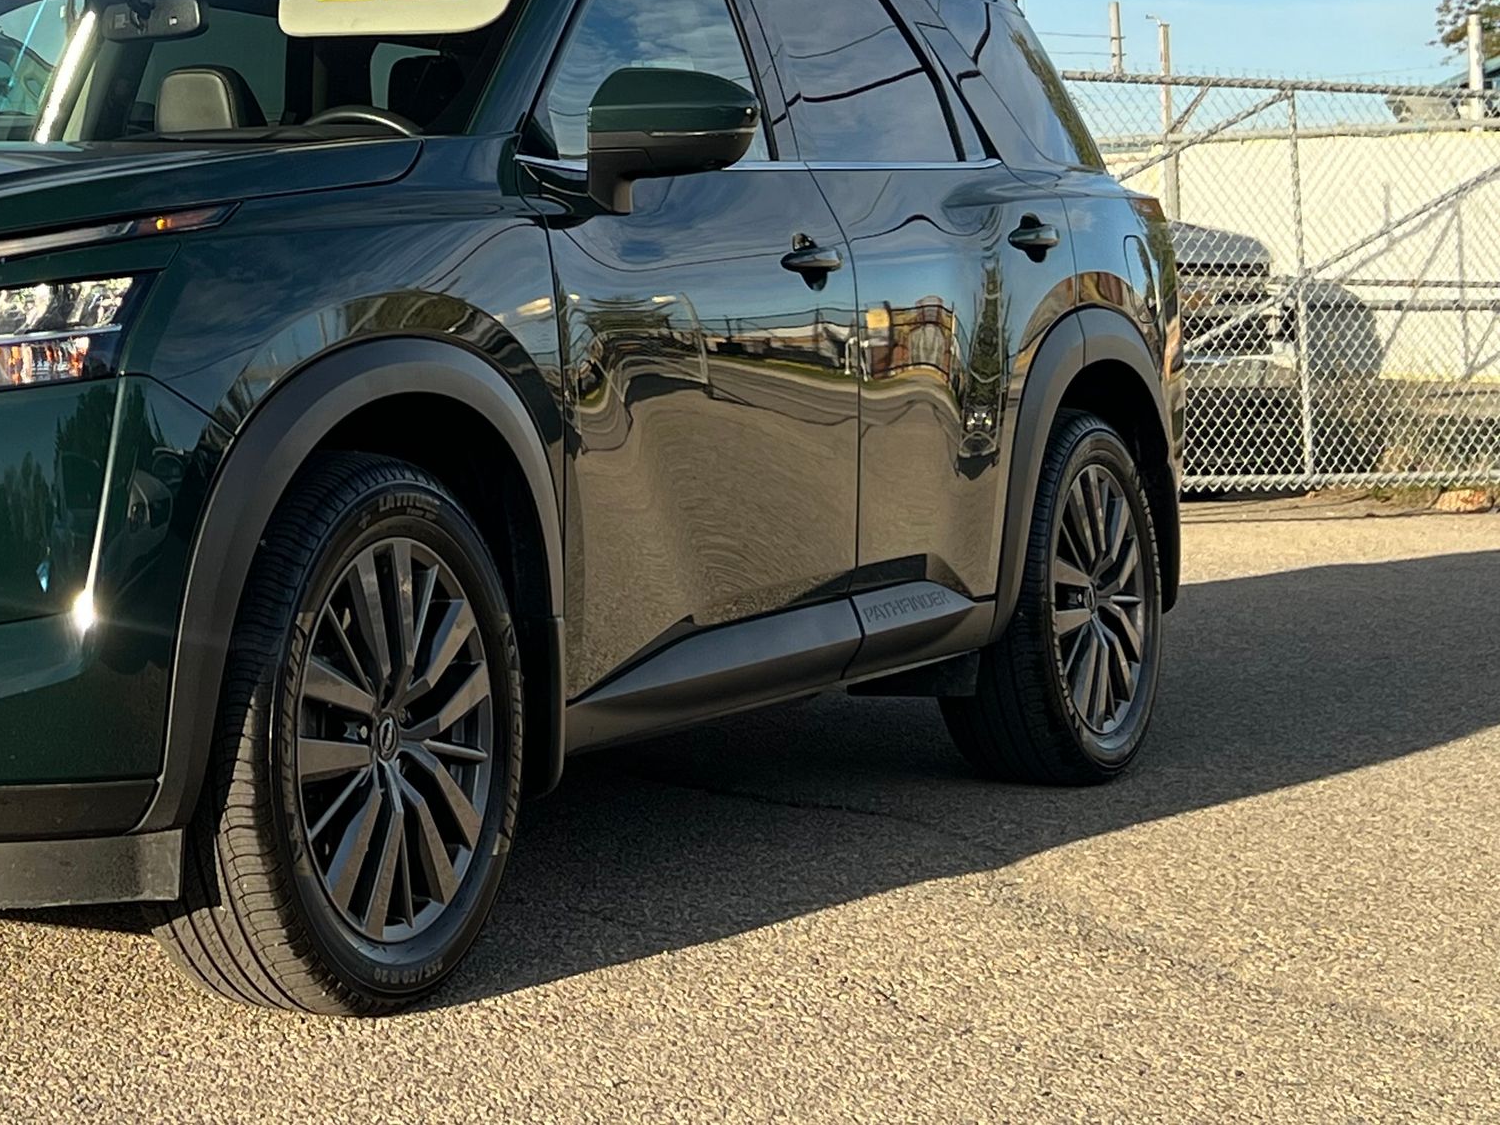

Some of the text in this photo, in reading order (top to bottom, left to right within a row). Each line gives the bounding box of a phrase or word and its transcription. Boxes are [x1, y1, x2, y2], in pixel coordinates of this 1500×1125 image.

[862, 590, 950, 623] PATHFINDER
[280, 625, 306, 813] MICHELIN
[503, 670, 522, 836] MICHELIN
